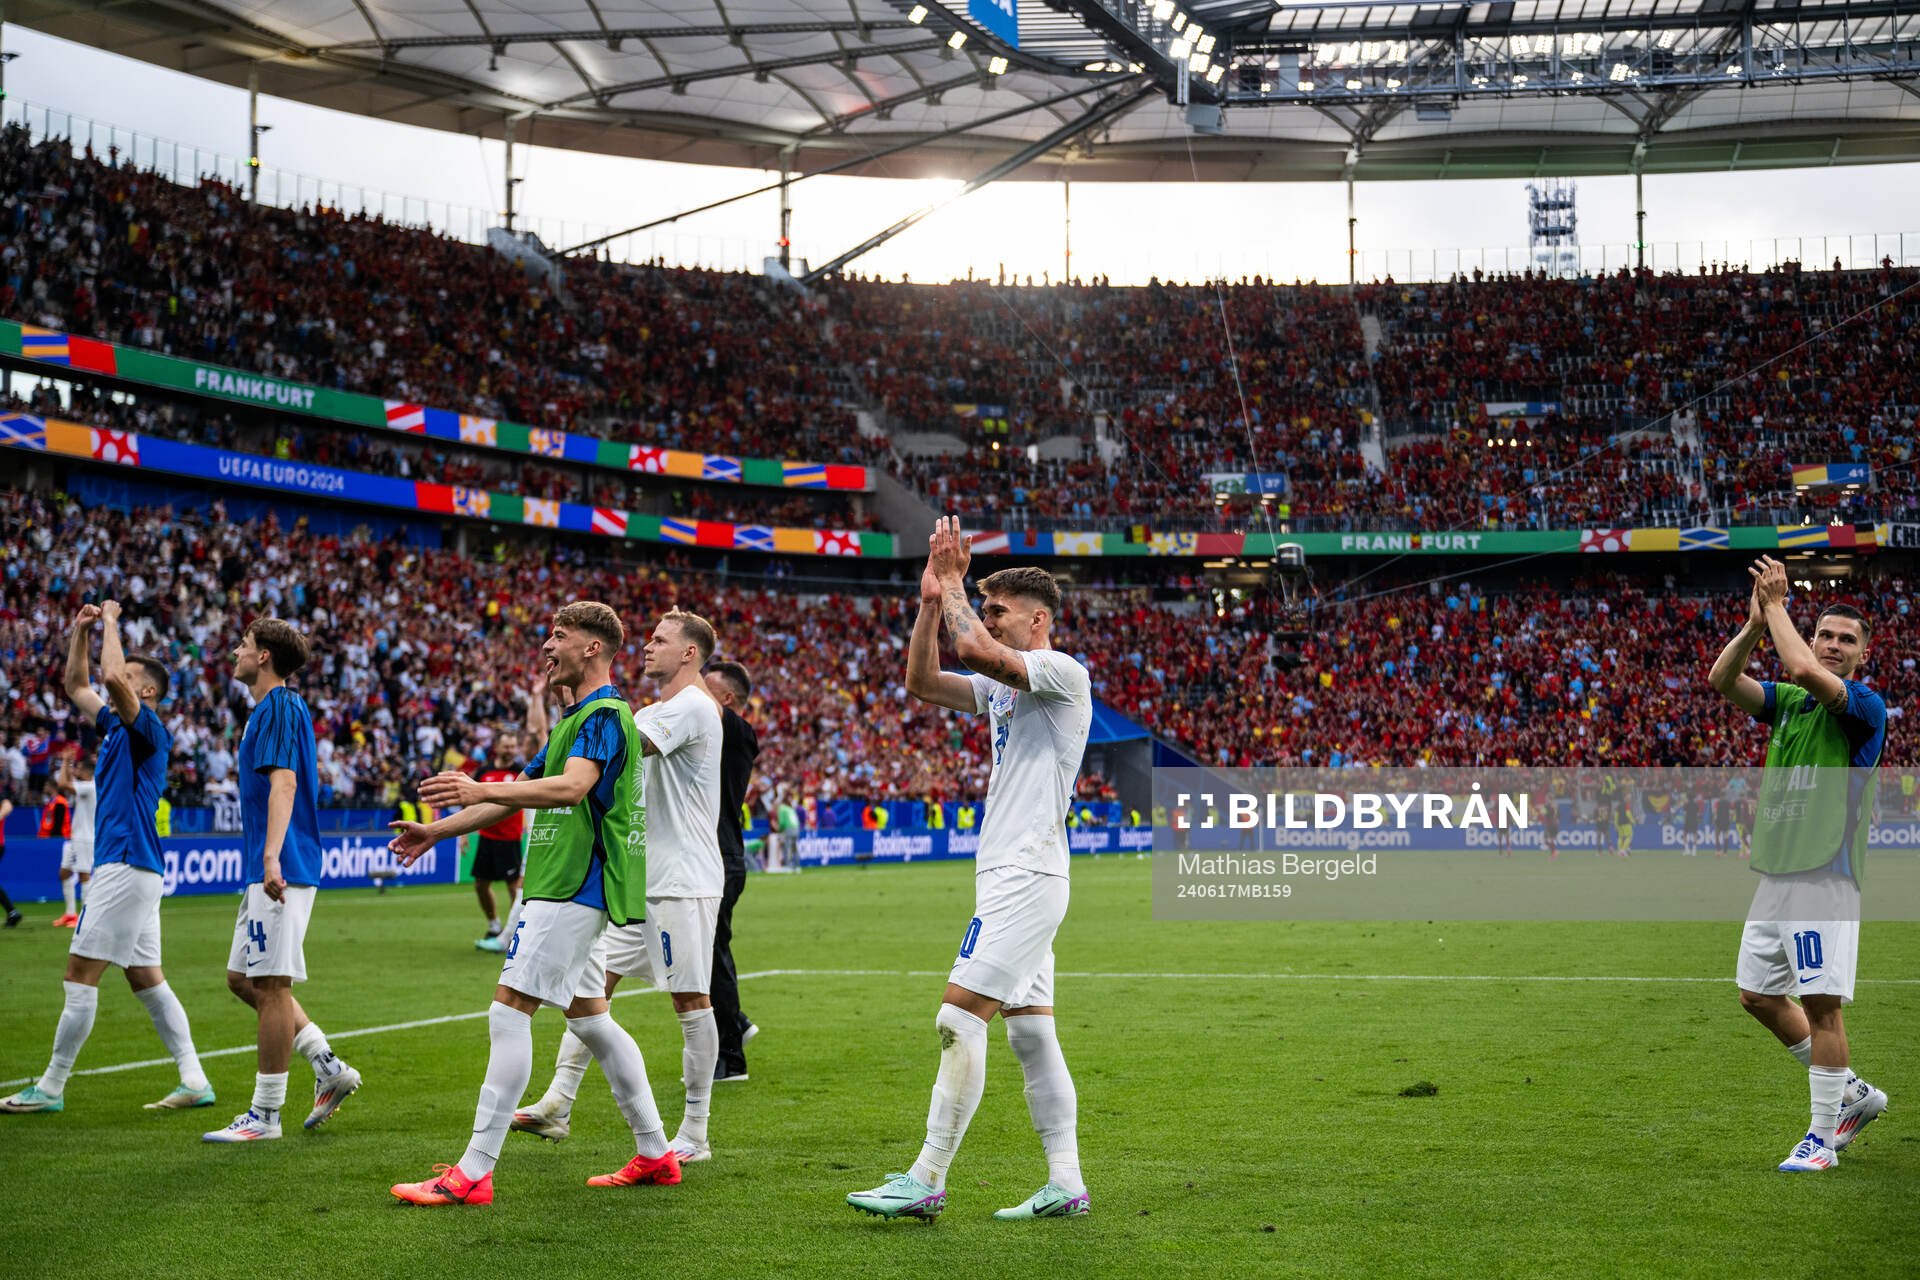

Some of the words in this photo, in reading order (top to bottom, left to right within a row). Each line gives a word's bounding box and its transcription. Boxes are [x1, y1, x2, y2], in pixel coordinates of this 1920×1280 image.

[195, 367, 315, 409] FRANKFURT
[1763, 804, 1808, 820] REPECT
[1275, 826, 1411, 851] Booking.com
[1794, 930, 1823, 970] 10
